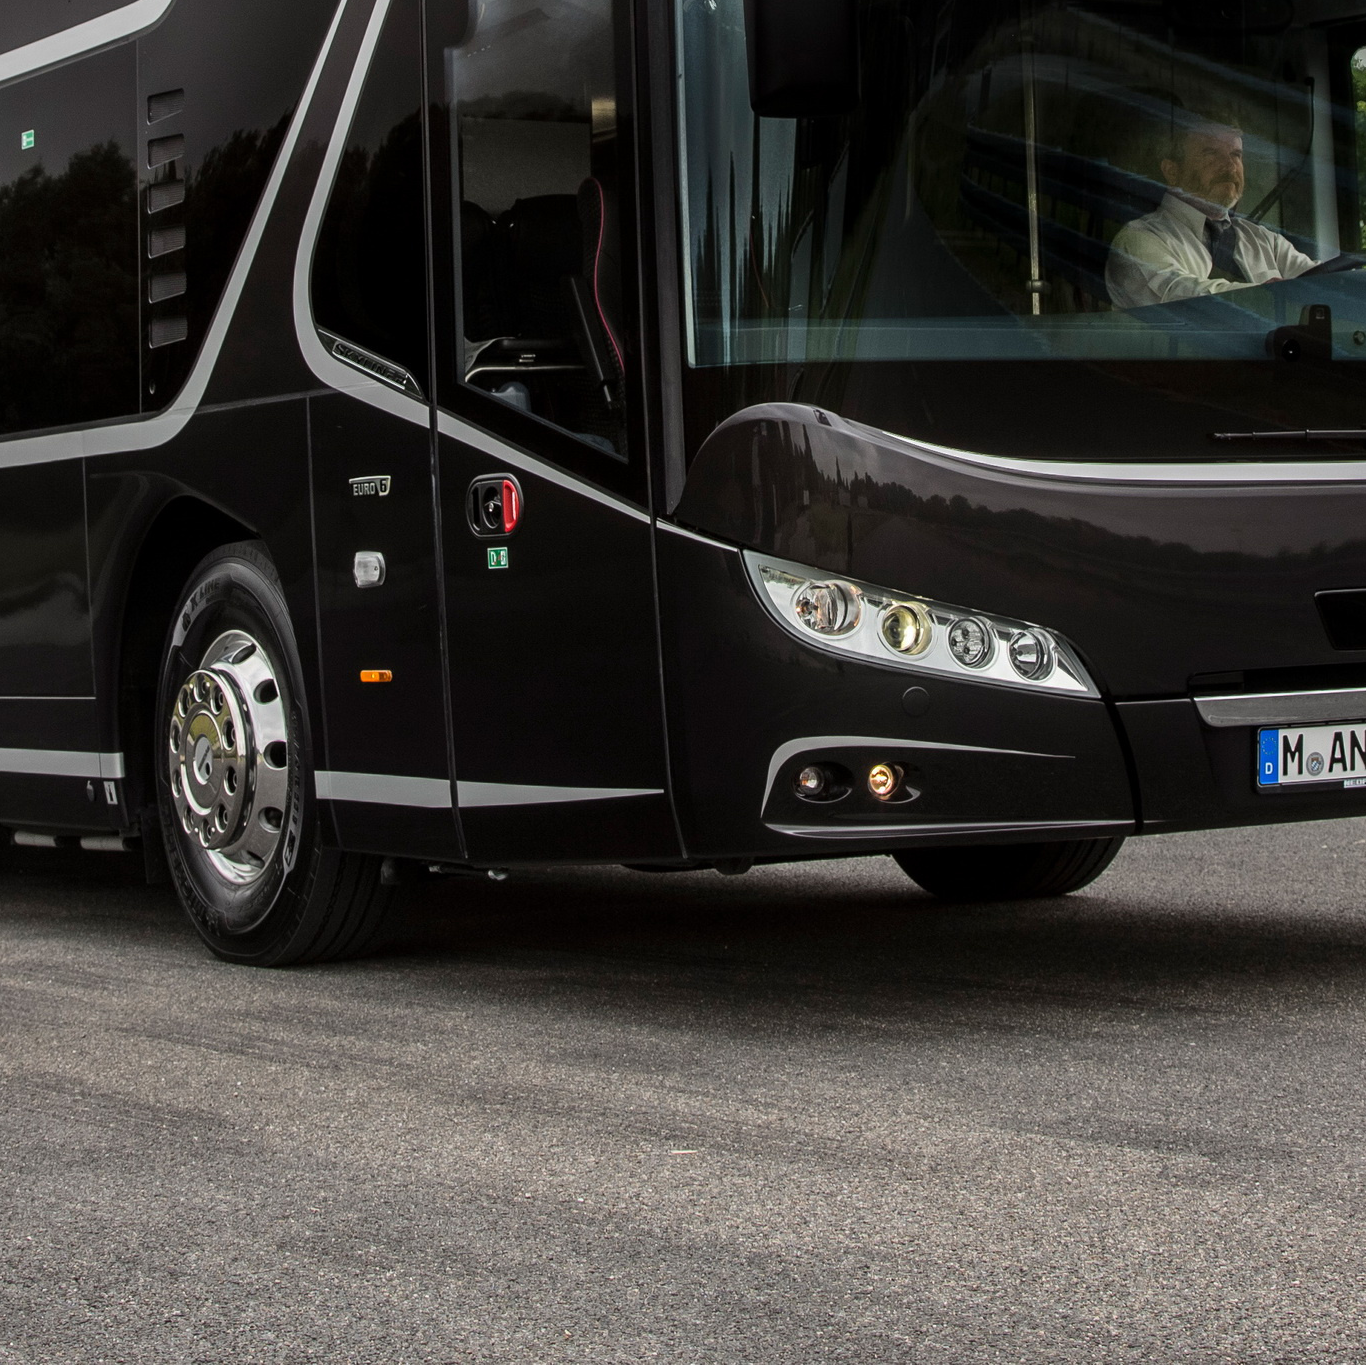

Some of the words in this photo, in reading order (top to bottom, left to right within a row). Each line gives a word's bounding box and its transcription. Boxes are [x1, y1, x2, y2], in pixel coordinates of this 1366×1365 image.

[353, 482, 376, 496] EURO
[380, 478, 387, 493] 6
[1283, 734, 1303, 776] M
[1265, 762, 1273, 775] D
